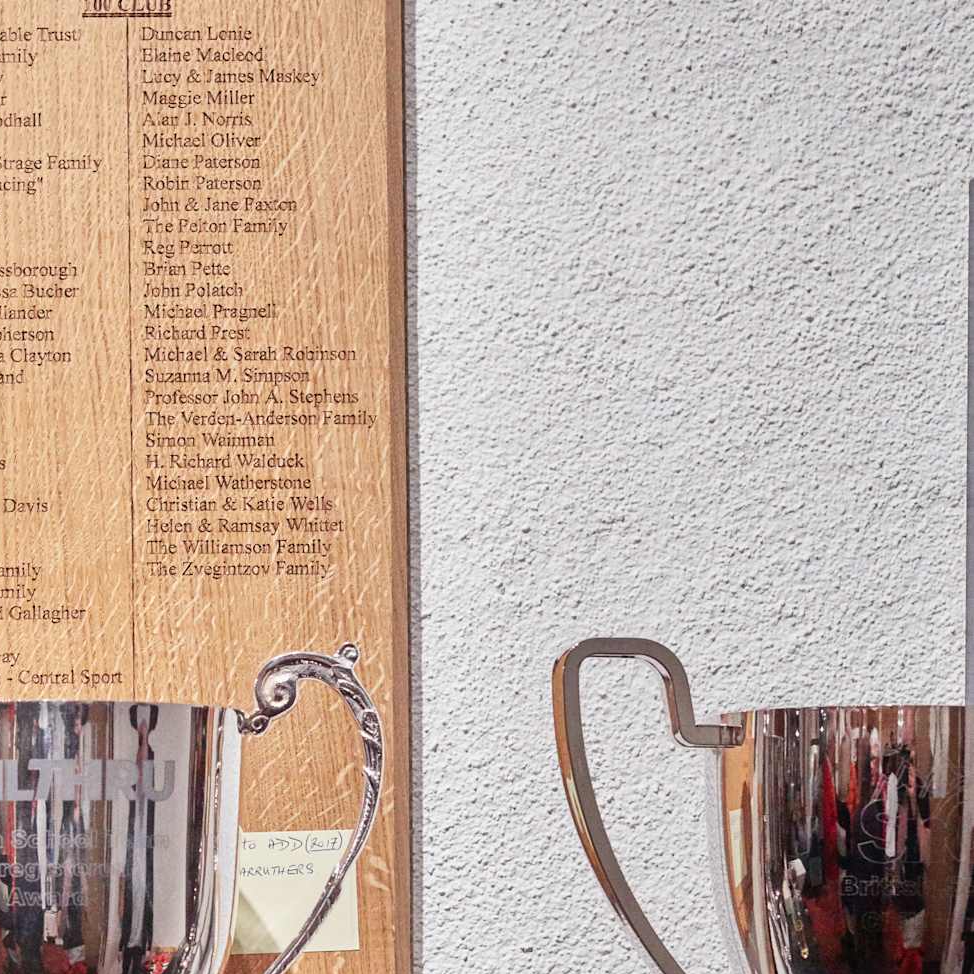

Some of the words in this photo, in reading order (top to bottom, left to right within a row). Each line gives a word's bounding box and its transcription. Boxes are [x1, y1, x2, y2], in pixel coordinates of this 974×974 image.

[118, 0, 171, 11] CLUB
[141, 27, 200, 40] Duncan
[141, 49, 190, 62] Elaine
[197, 48, 263, 61] Macleod
[142, 91, 201, 108] Maggie
[207, 91, 255, 104] Miller
[143, 134, 205, 148] Michael
[212, 133, 260, 147] Oliver
[144, 177, 189, 190] Robin
[197, 176, 261, 189] Paterson
[144, 284, 179, 297] John
[145, 305, 206, 318] Michael
[145, 326, 206, 340] Richard
[145, 369, 209, 383] Suzanna
[216, 369, 237, 382] M.
[243, 369, 309, 385] Simpson
[146, 391, 218, 404] Professor
[223, 390, 258, 404] John
[266, 391, 282, 403] A.
[289, 390, 358, 407] Stephens
[146, 434, 194, 447] Simon
[202, 433, 274, 446] Wainman
[147, 455, 164, 468] H.
[170, 454, 230, 468] Richard
[237, 454, 304, 468] Walduck
[147, 476, 209, 490] Michael
[216, 475, 311, 489] Watherstone
[147, 541, 177, 554] The
[183, 541, 270, 554] Williamson
[277, 540, 330, 555] Family
[241, 838, 255, 849] to
